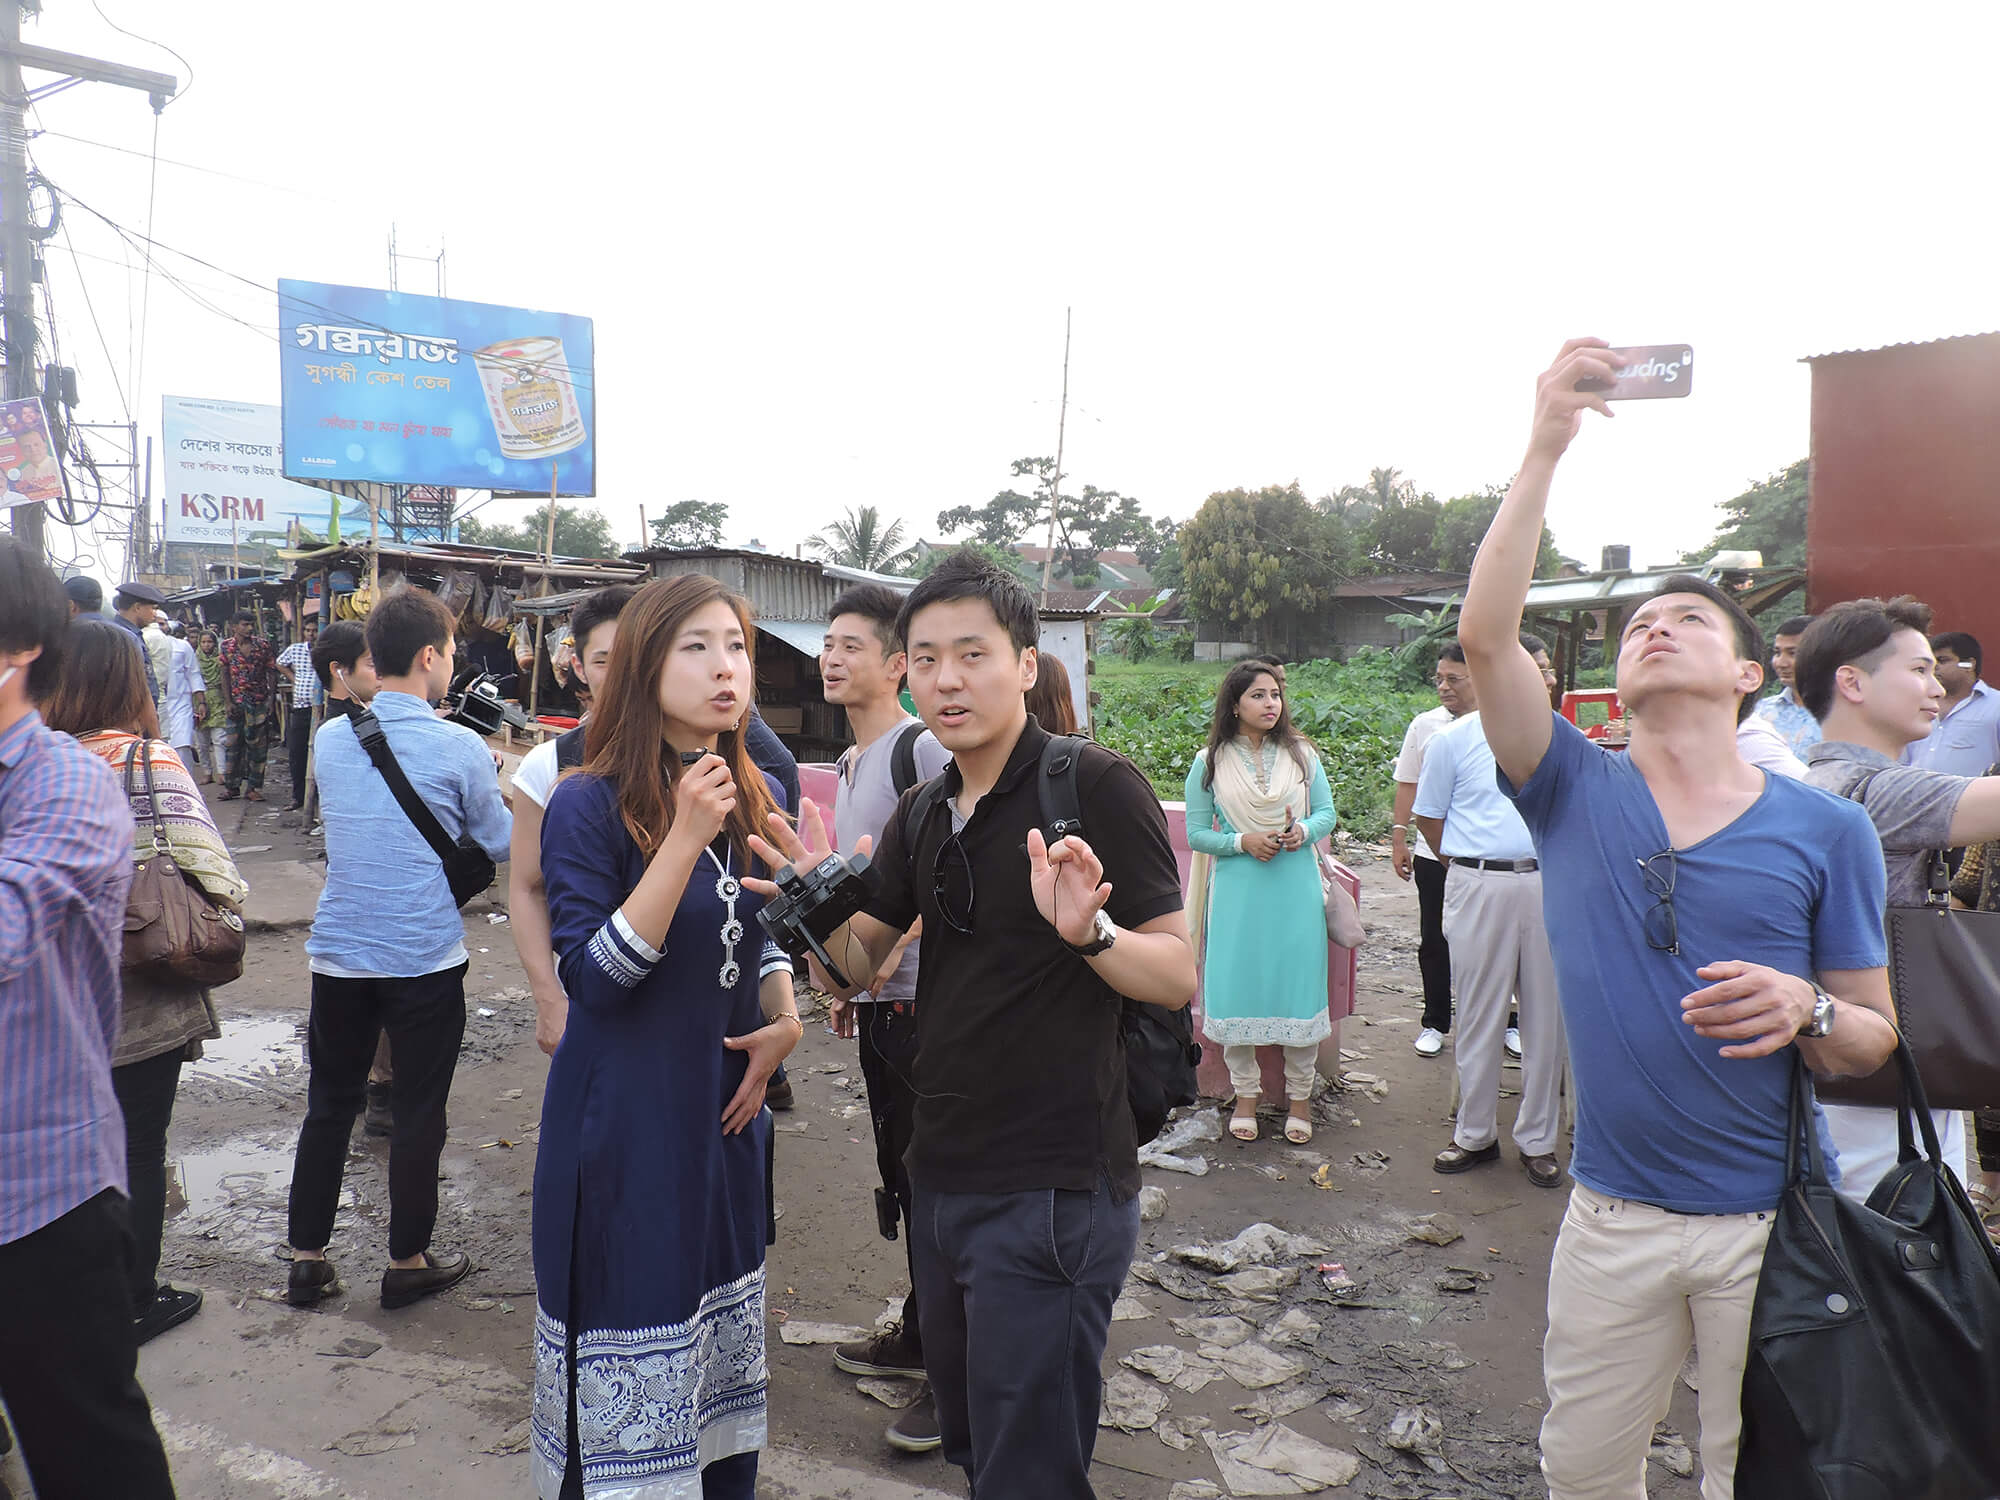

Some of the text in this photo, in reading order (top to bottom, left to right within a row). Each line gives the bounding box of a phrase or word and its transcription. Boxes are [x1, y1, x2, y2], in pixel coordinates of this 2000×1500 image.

[295, 322, 459, 365] গন্ধরাজ
[305, 361, 451, 393] সুগন্ধী কেশ তেল
[180, 438, 221, 453] দেশের
[225, 442, 273, 457] সবচেয়ে
[181, 493, 264, 523] KSRM
